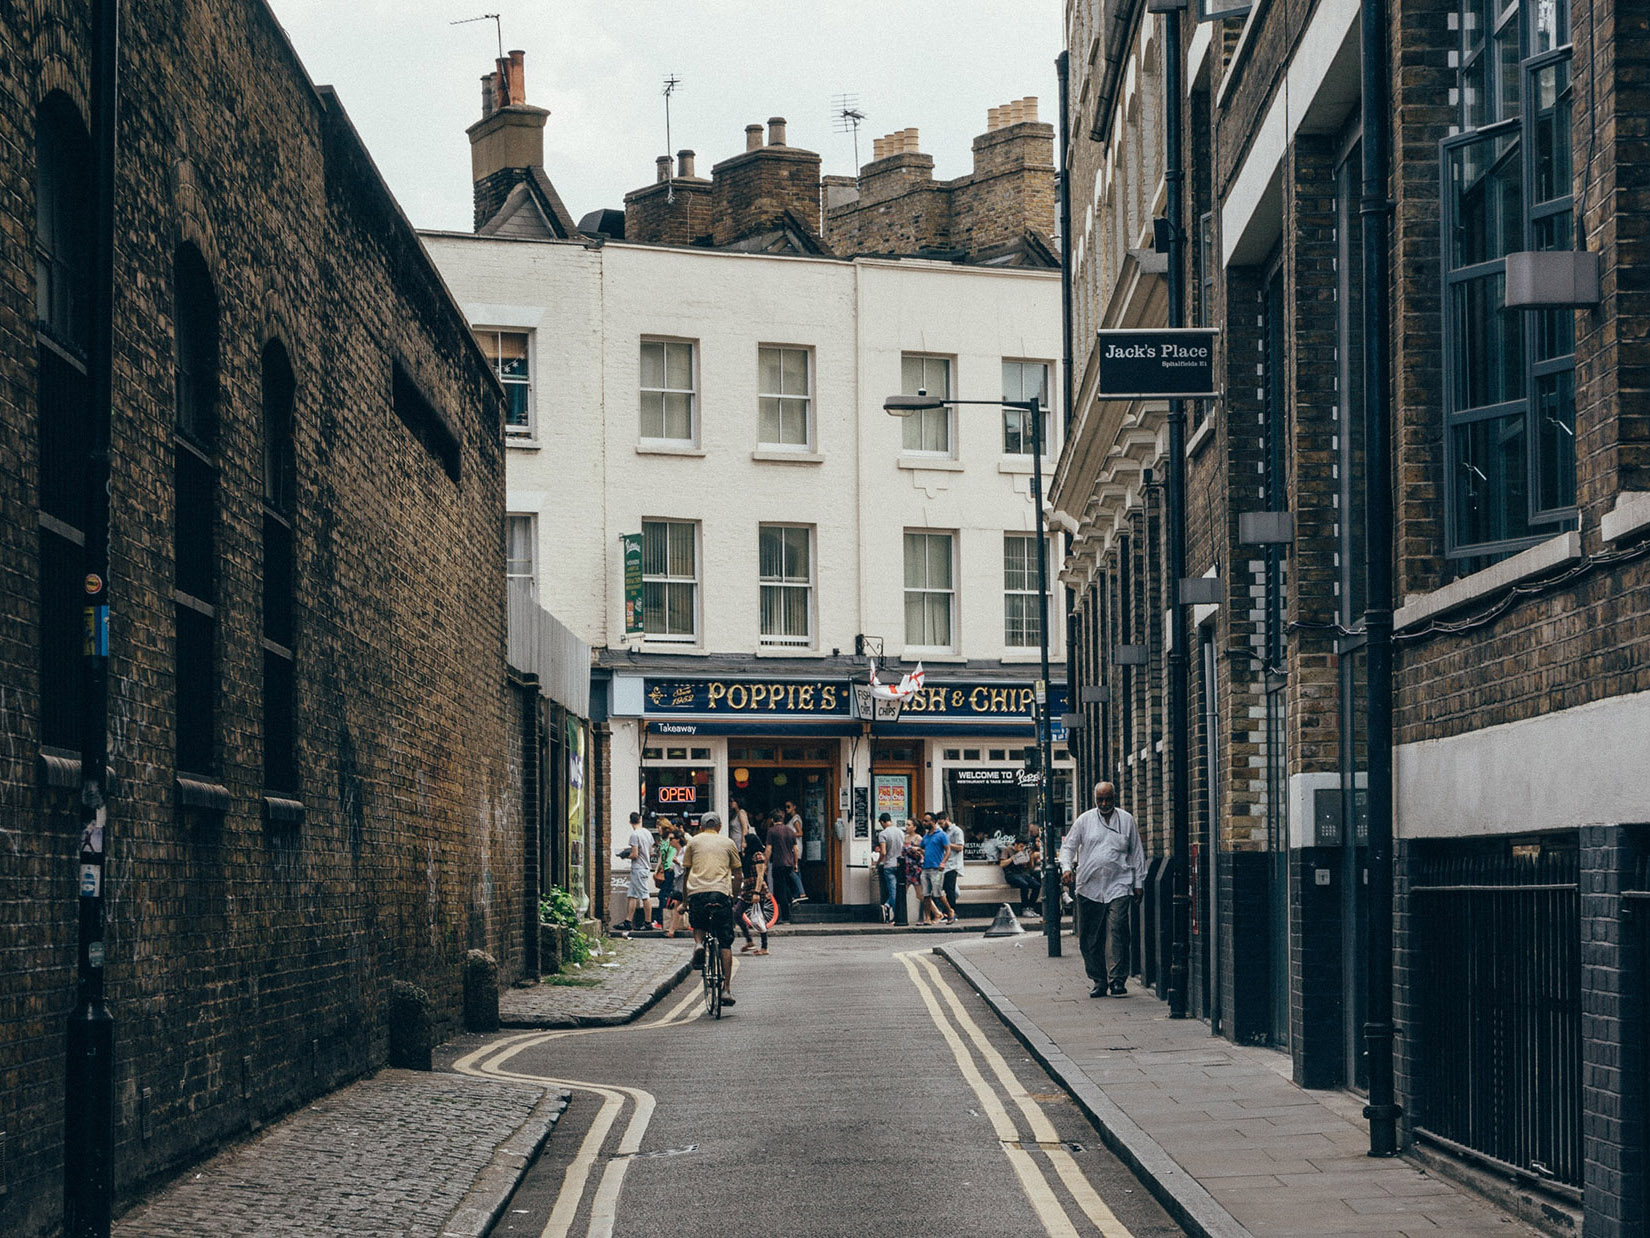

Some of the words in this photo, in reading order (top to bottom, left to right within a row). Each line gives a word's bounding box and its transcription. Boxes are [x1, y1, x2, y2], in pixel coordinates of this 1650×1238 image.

[1105, 343, 1156, 358] Jack's
[1161, 344, 1208, 358] Place
[1161, 360, 1198, 368] Spitalfields
[707, 682, 837, 710] POPPIE'S
[857, 689, 871, 701] FISH
[902, 687, 947, 712] SH
[951, 690, 965, 708] &
[969, 687, 1035, 712] CHIP
[878, 706, 896, 717] CHIPS
[658, 723, 697, 735] Takeaway
[958, 771, 1000, 779] WELCOME
[1001, 771, 1013, 779] TO
[660, 788, 695, 802] OPEN
